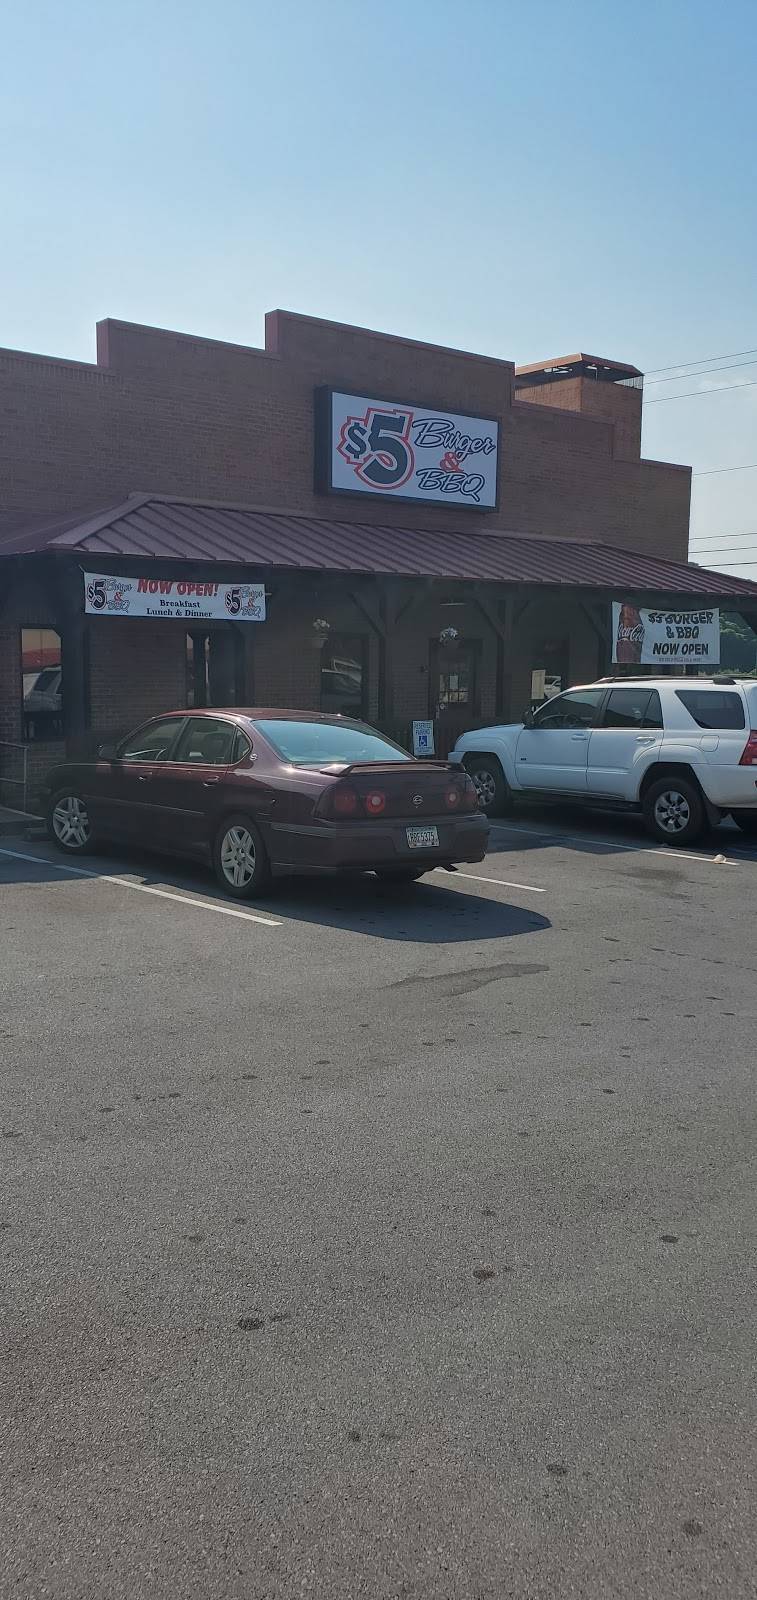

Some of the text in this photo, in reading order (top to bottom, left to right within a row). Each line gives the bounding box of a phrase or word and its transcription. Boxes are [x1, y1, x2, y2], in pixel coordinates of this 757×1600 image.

[343, 411, 496, 487] $5 Burger
[440, 451, 464, 472] &
[416, 468, 485, 502] BBQ
[88, 579, 107, 610] $5
[114, 591, 123, 601] &
[137, 577, 219, 597] NOW OPEN!
[160, 599, 201, 609] Breakfast
[225, 587, 242, 616] $5
[146, 607, 173, 616] Lunch
[185, 609, 213, 618] Dinner
[665, 625, 700, 639] & BBQ
[652, 642, 709, 656] NOW OPEN
